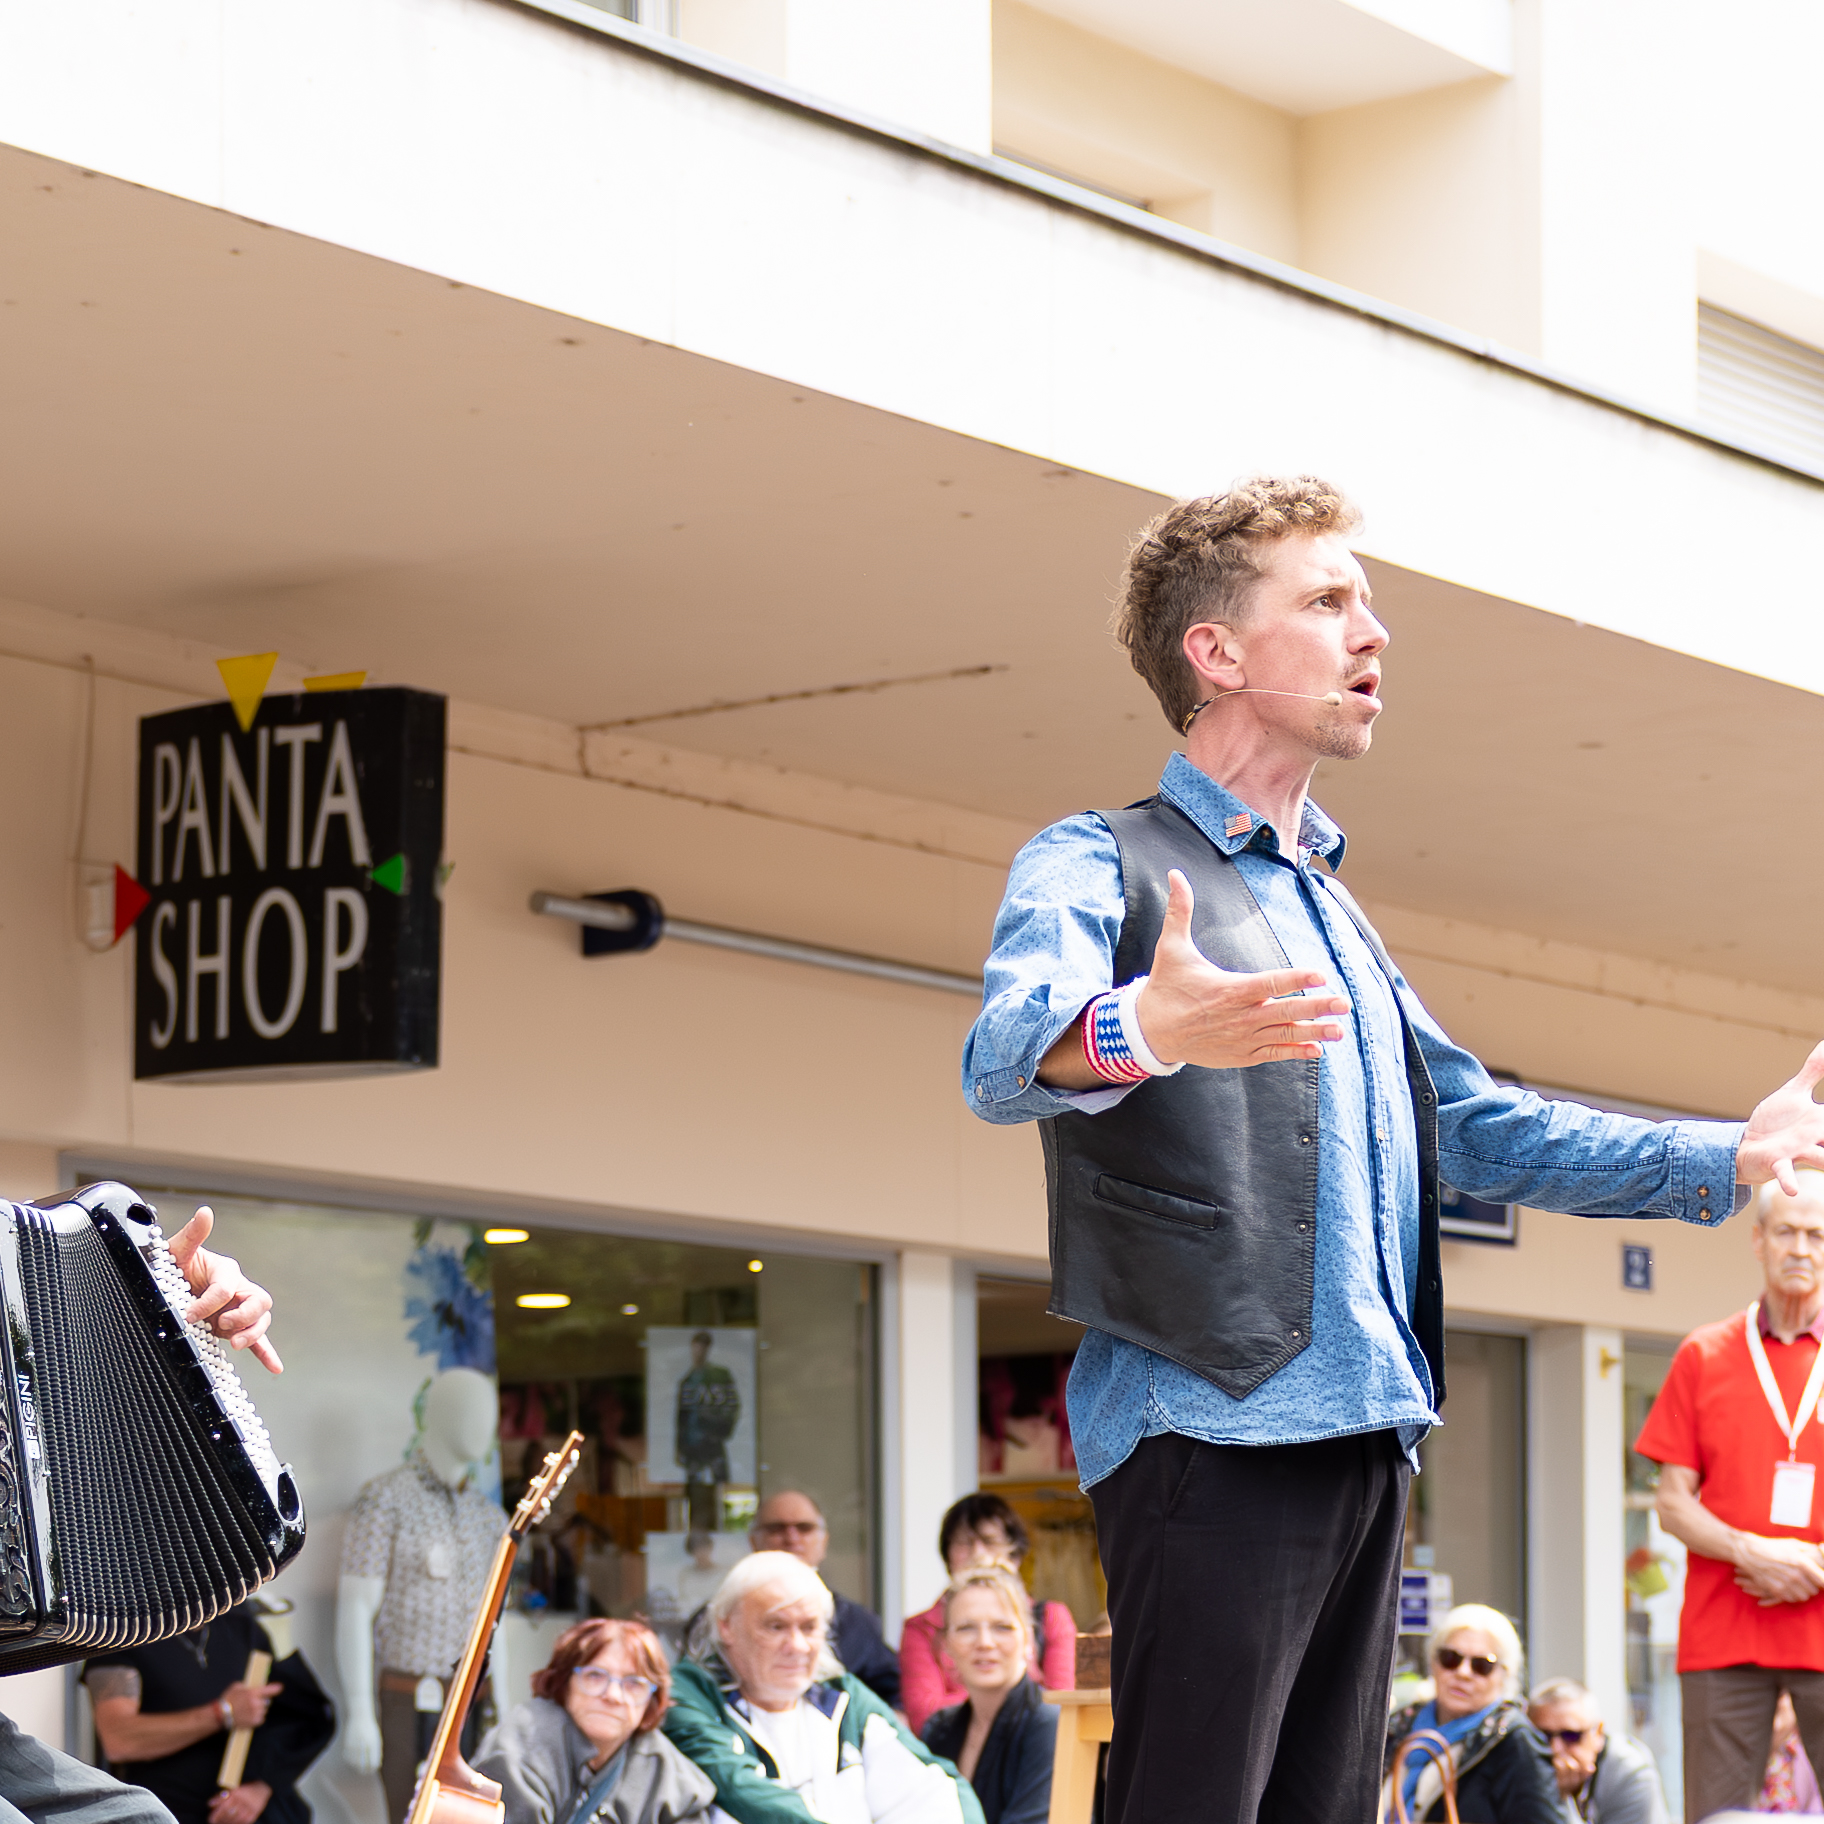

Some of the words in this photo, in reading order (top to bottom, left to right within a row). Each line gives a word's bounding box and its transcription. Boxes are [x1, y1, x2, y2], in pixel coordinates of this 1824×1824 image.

[152, 720, 372, 886] PANTA
[150, 886, 370, 1049] SHOP
[17, 1373, 38, 1440] PIGINI
